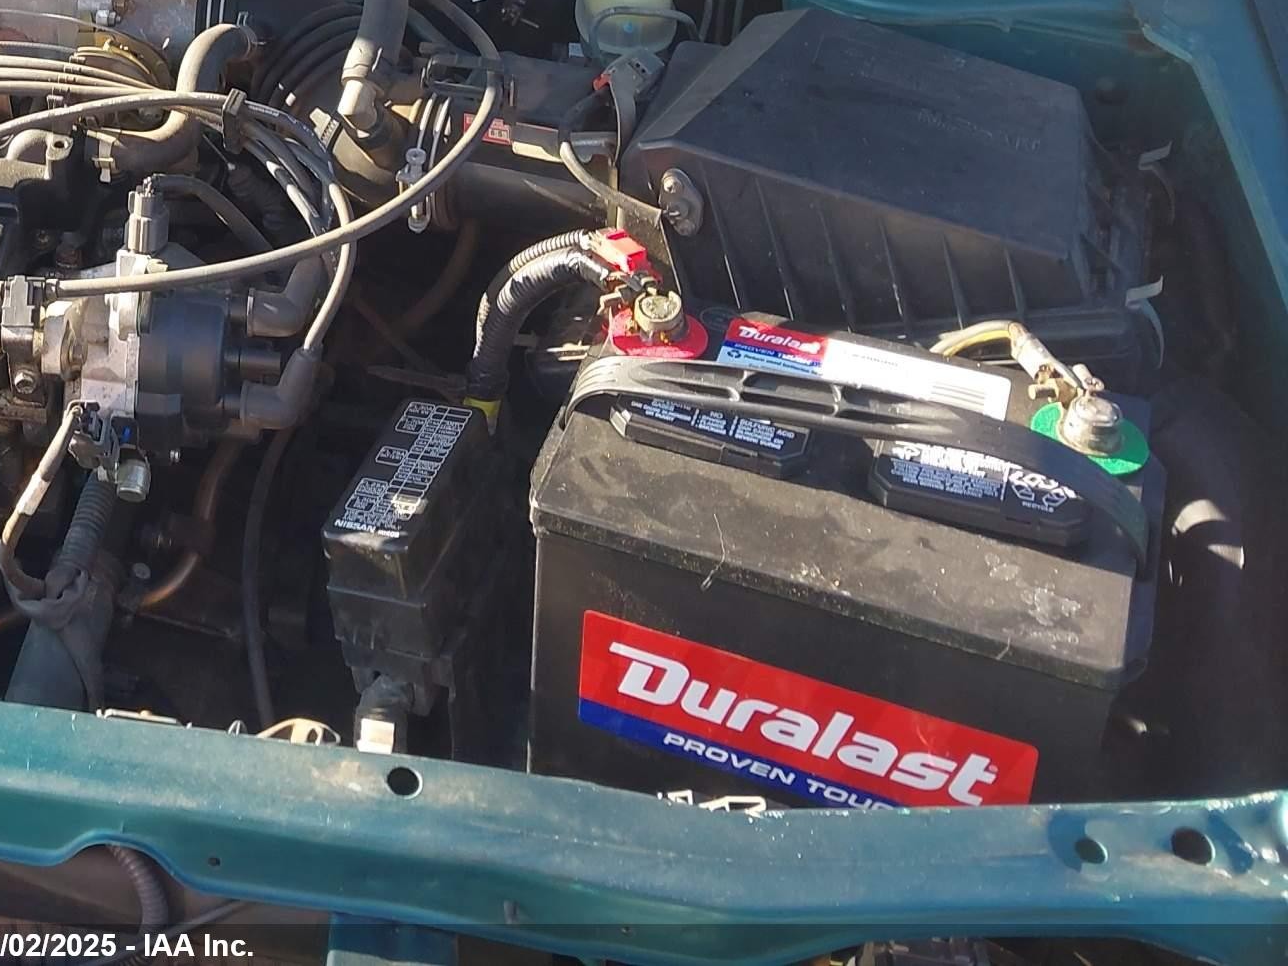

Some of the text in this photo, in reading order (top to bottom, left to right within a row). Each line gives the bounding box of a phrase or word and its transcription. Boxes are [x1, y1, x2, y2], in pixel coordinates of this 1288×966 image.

[710, 411, 723, 419] NO
[334, 519, 377, 533] NISSAN
[609, 641, 998, 807] Duralast
[663, 731, 796, 786] PROVEN
